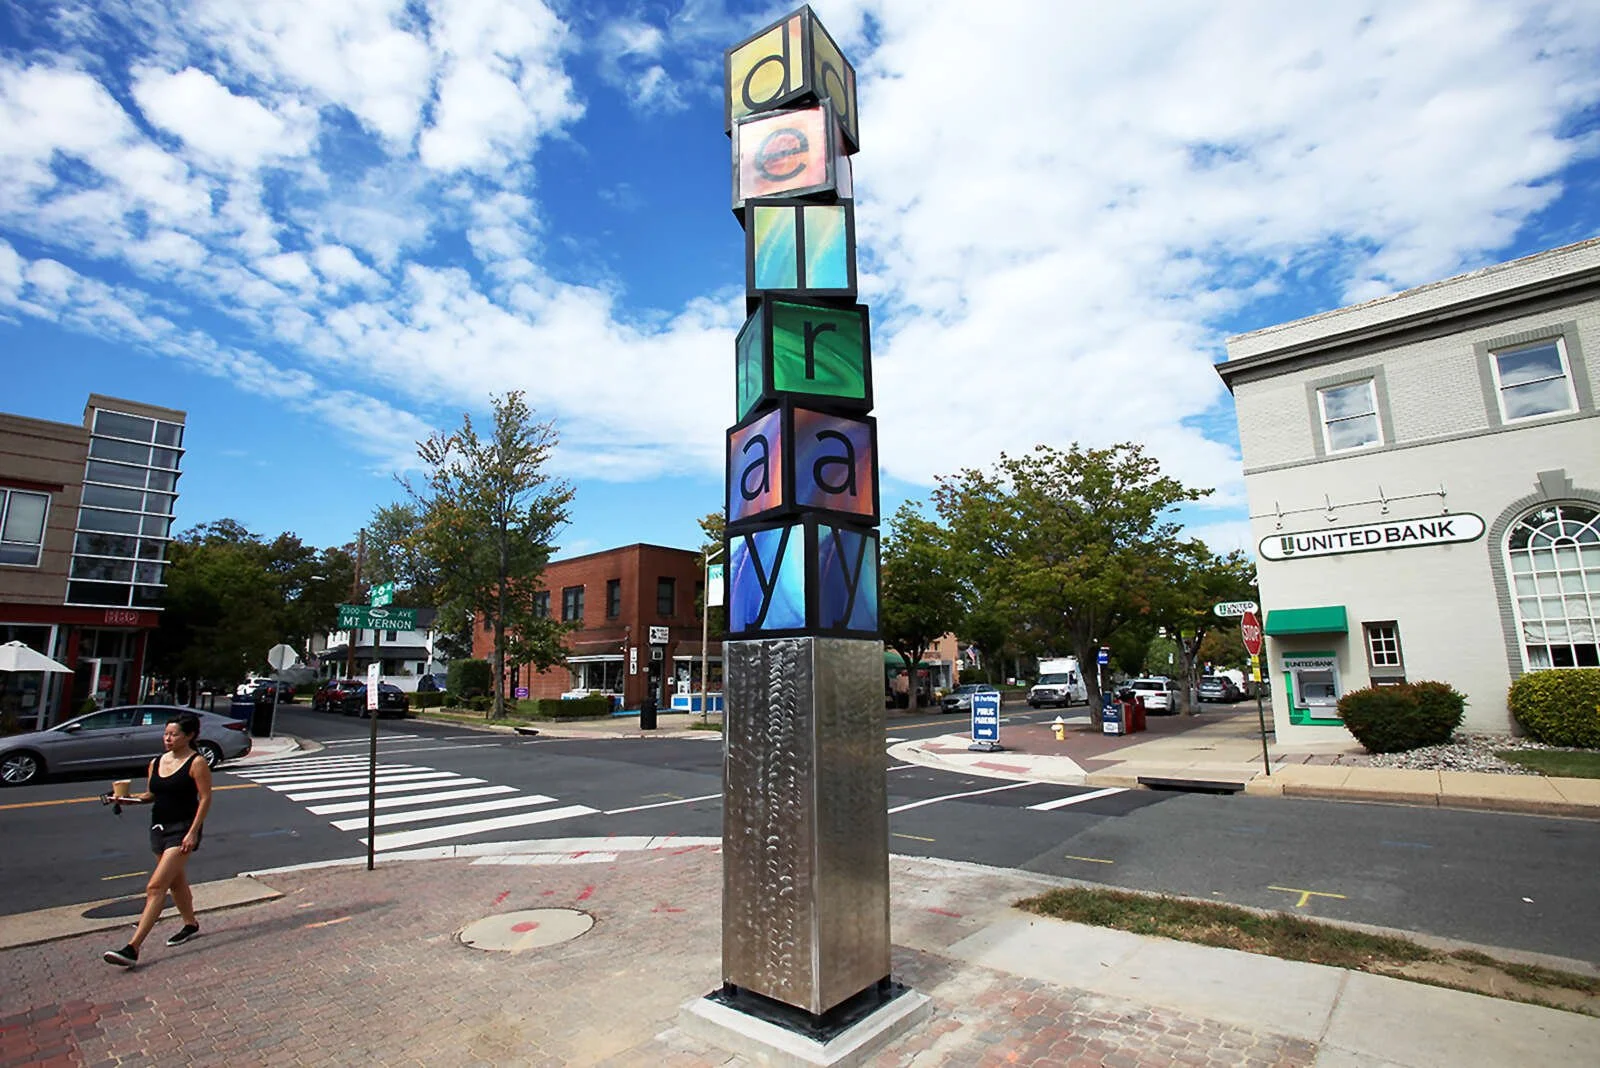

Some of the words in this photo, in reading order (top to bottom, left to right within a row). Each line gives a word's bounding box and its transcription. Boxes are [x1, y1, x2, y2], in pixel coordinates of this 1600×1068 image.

[755, 128, 808, 181] e
[803, 321, 836, 380] r
[740, 433, 770, 501] a
[812, 429, 857, 497] a
[1296, 529, 1382, 552] UNITED
[1386, 520, 1455, 543] BANK
[743, 526, 792, 630] y
[831, 527, 867, 629] y
[341, 606, 361, 615] 2300
[1226, 602, 1254, 611] UNITED
[367, 618, 412, 630] VERNON
[1242, 625, 1259, 641] STOP
[975, 716, 997, 724] PARKING
[976, 708, 995, 716] PUBLIC
